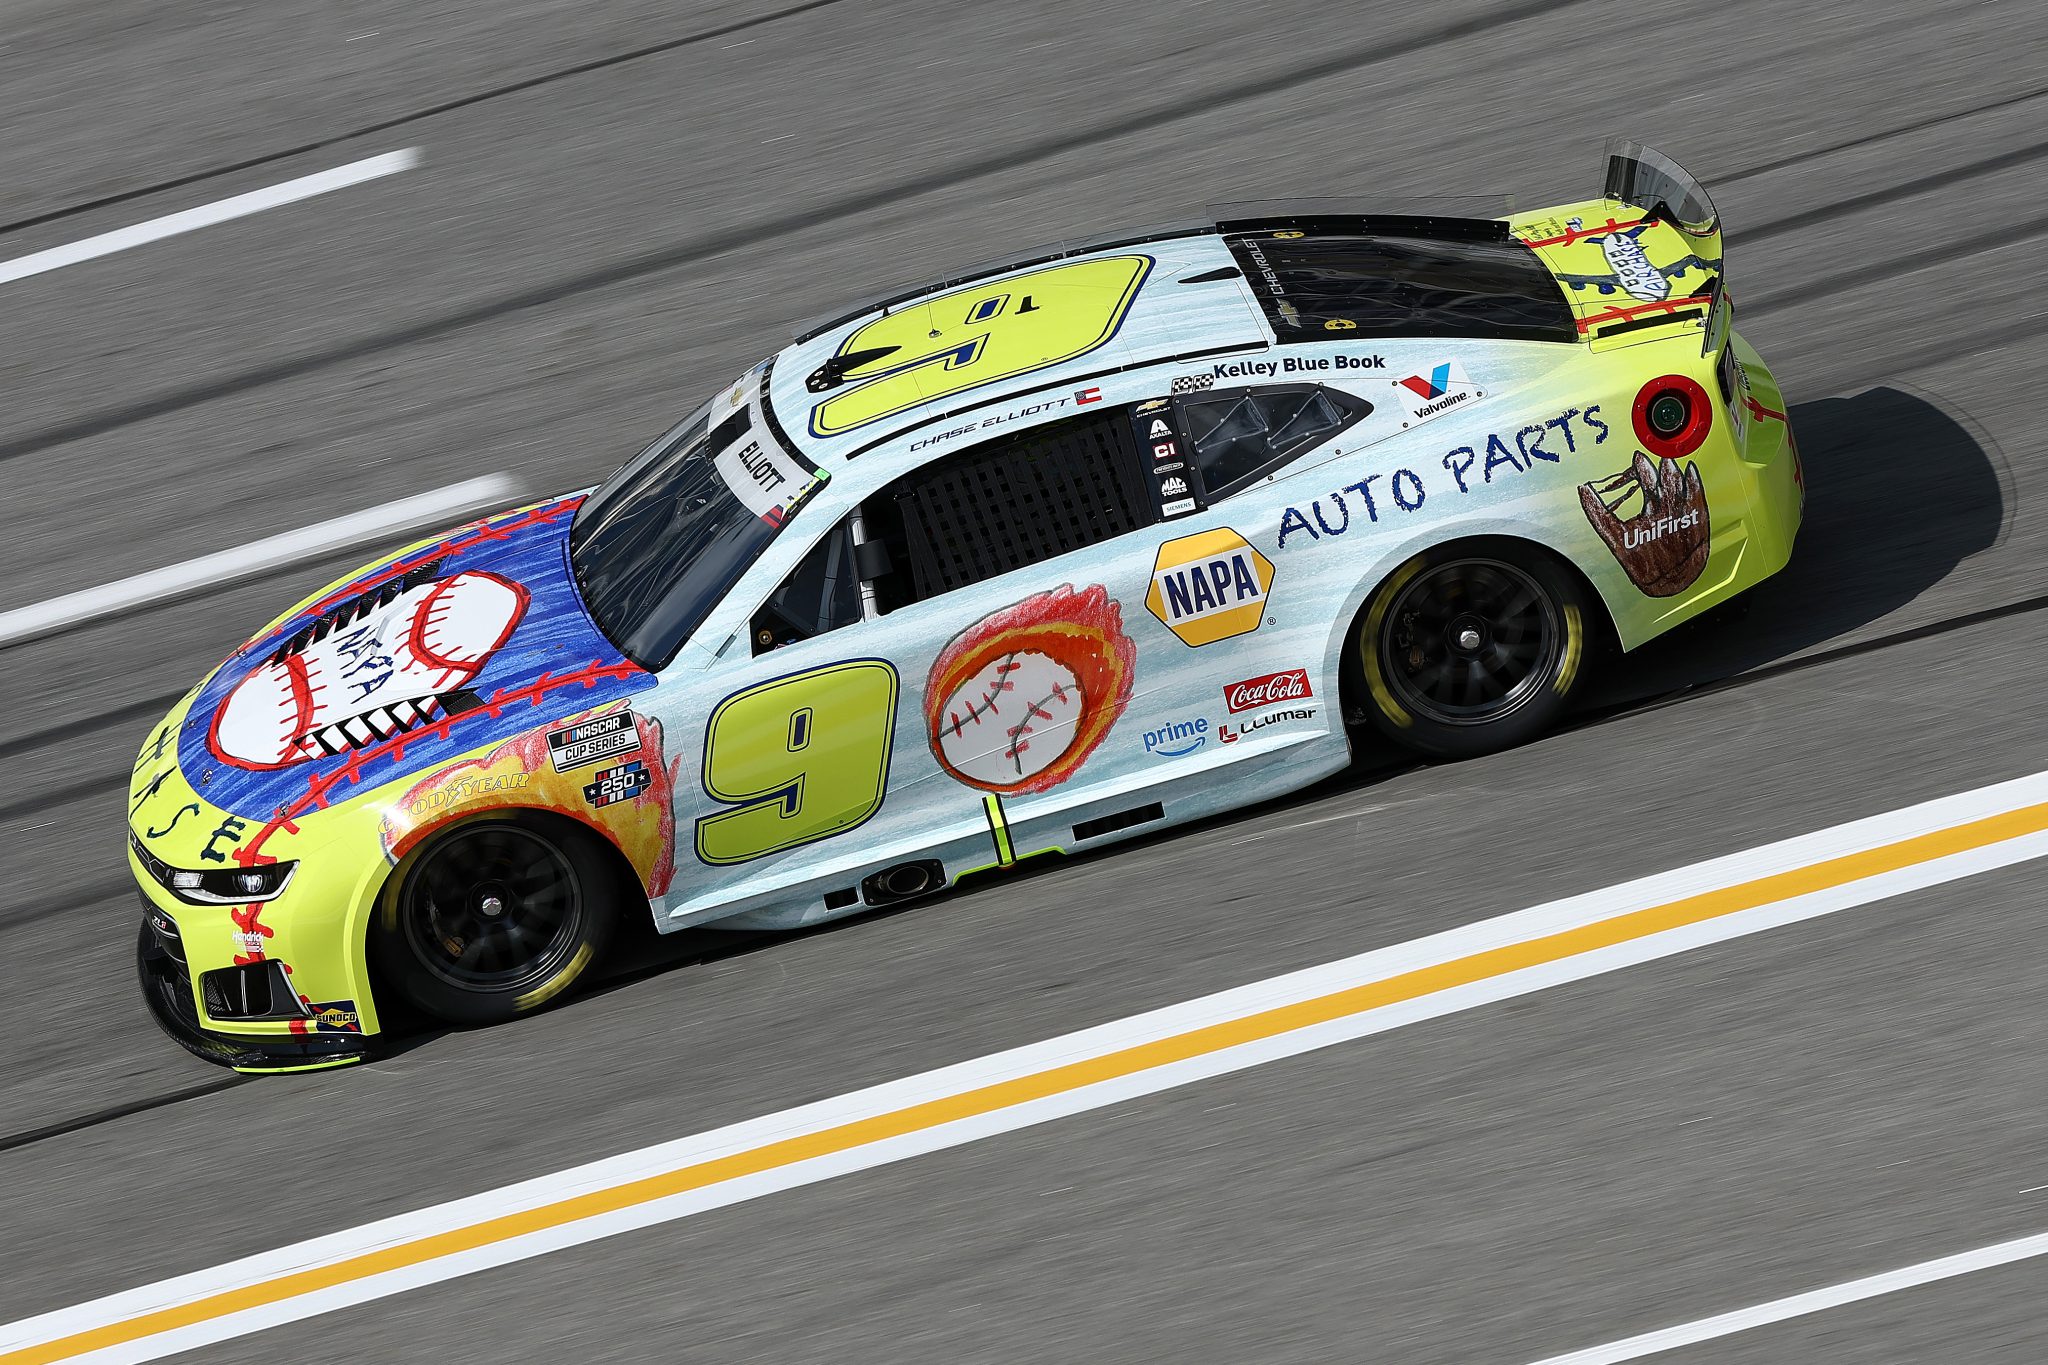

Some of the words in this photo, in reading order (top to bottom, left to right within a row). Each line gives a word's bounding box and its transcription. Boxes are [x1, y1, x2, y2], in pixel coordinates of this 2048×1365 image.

[1241, 237, 1284, 296] CHEVROLET
[1213, 361, 1278, 379] Kelley
[1283, 357, 1329, 373] Blue
[1335, 355, 1386, 370] Book
[1413, 392, 1468, 419] Valvoline
[909, 423, 978, 452] CHASE
[983, 398, 1071, 428] ELLIOTT
[1149, 430, 1173, 440] AXALTA
[738, 440, 786, 493] ELLIOTT
[1277, 469, 1426, 548] AUTO
[1442, 405, 1609, 493] PARTS
[1161, 477, 1186, 493] MAC
[1162, 487, 1188, 497] TOOLS
[1166, 502, 1192, 512] SIEMENS
[1623, 508, 1700, 549] UniFirst
[1164, 554, 1259, 619] NAPA
[333, 625, 394, 704] NAPA
[1230, 672, 1305, 710] Coca-Cola
[576, 716, 620, 740] NASCAR
[1142, 717, 1209, 752] prime
[565, 745, 587, 760] CUP
[588, 733, 626, 753] SERIES
[694, 657, 900, 867] 9
[601, 773, 635, 795] 250
[314, 1012, 356, 1023] SUNOCO
